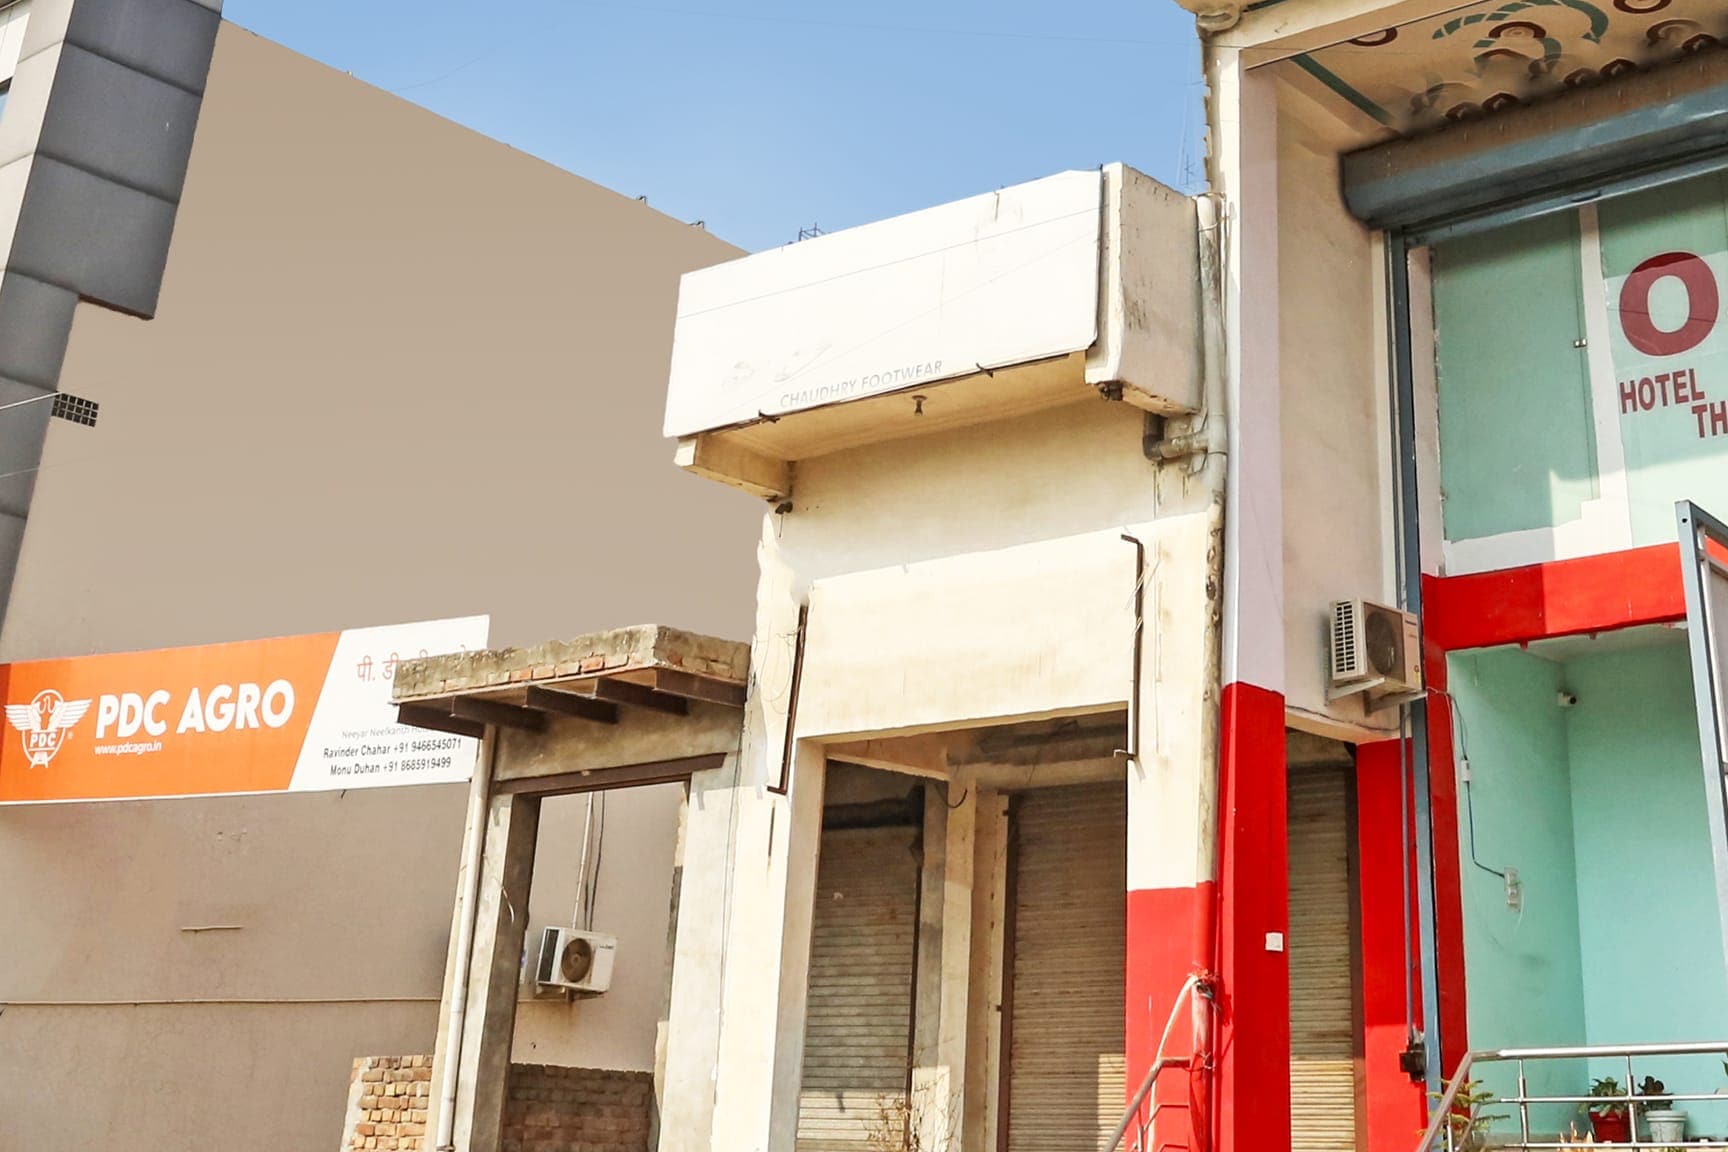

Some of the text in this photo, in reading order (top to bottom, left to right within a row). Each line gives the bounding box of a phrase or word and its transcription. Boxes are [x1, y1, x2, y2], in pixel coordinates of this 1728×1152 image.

[779, 379, 857, 409] CHAUDHRY
[861, 360, 943, 389] FOOTWEAR
[1619, 368, 1705, 414] HOTEL
[95, 679, 295, 739] PDC AGRO
[29, 733, 57, 748] PDC
[94, 740, 162, 756] www.pdcagro.in
[323, 745, 359, 759] Ravinder
[361, 743, 391, 757] Chahar
[393, 741, 409, 754] +91
[330, 763, 352, 777] Monu
[354, 761, 381, 775] Duhan
[383, 760, 398, 773] +91
